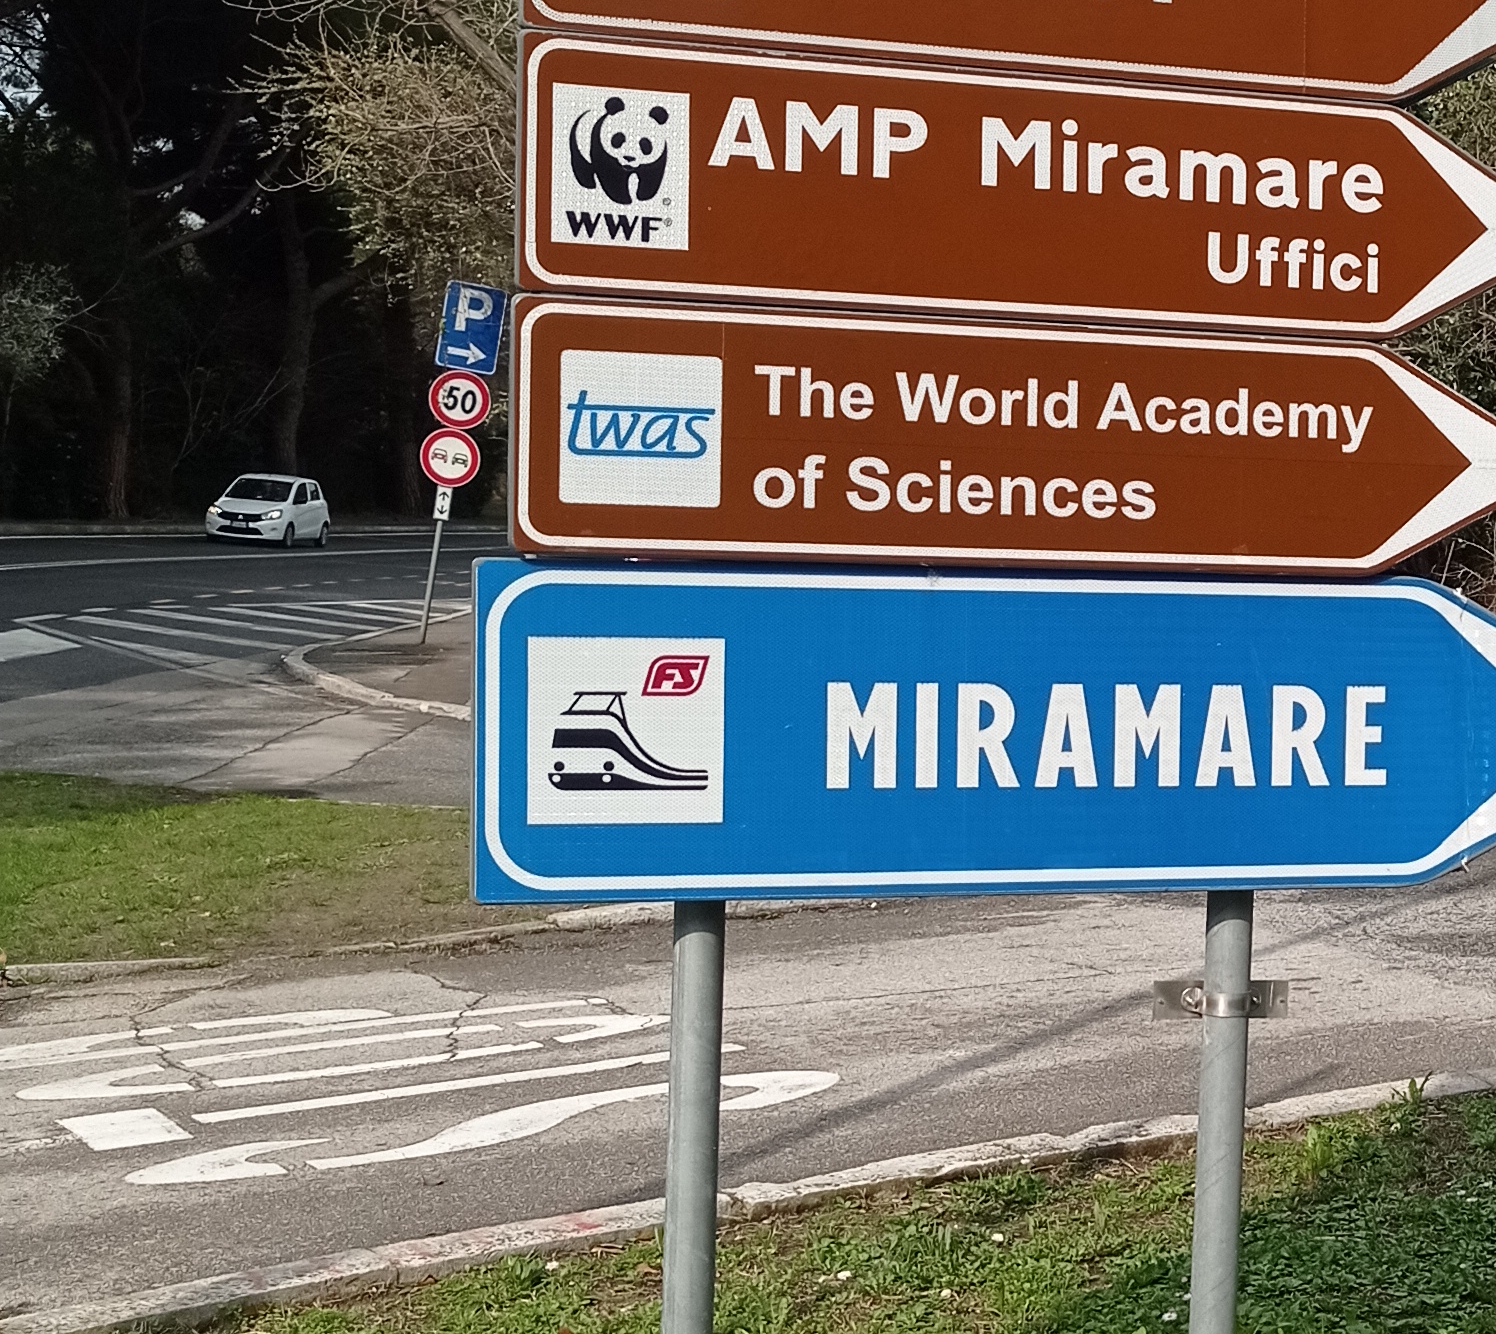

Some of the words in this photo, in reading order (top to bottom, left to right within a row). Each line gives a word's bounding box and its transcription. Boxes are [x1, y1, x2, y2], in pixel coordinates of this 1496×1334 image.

[707, 96, 928, 179] AMP
[980, 115, 1385, 214] Miramare
[566, 210, 663, 243] WWF
[1207, 231, 1379, 294] Uffici
[454, 287, 493, 332] P
[443, 385, 477, 414] 50
[567, 390, 715, 459] twas
[754, 364, 875, 421] The
[895, 371, 1079, 429] World
[1096, 382, 1374, 454] Academy
[753, 454, 827, 509] of
[845, 456, 1157, 520] Sciences
[651, 662, 701, 690] FS
[826, 681, 1387, 789] MIRAMARE
